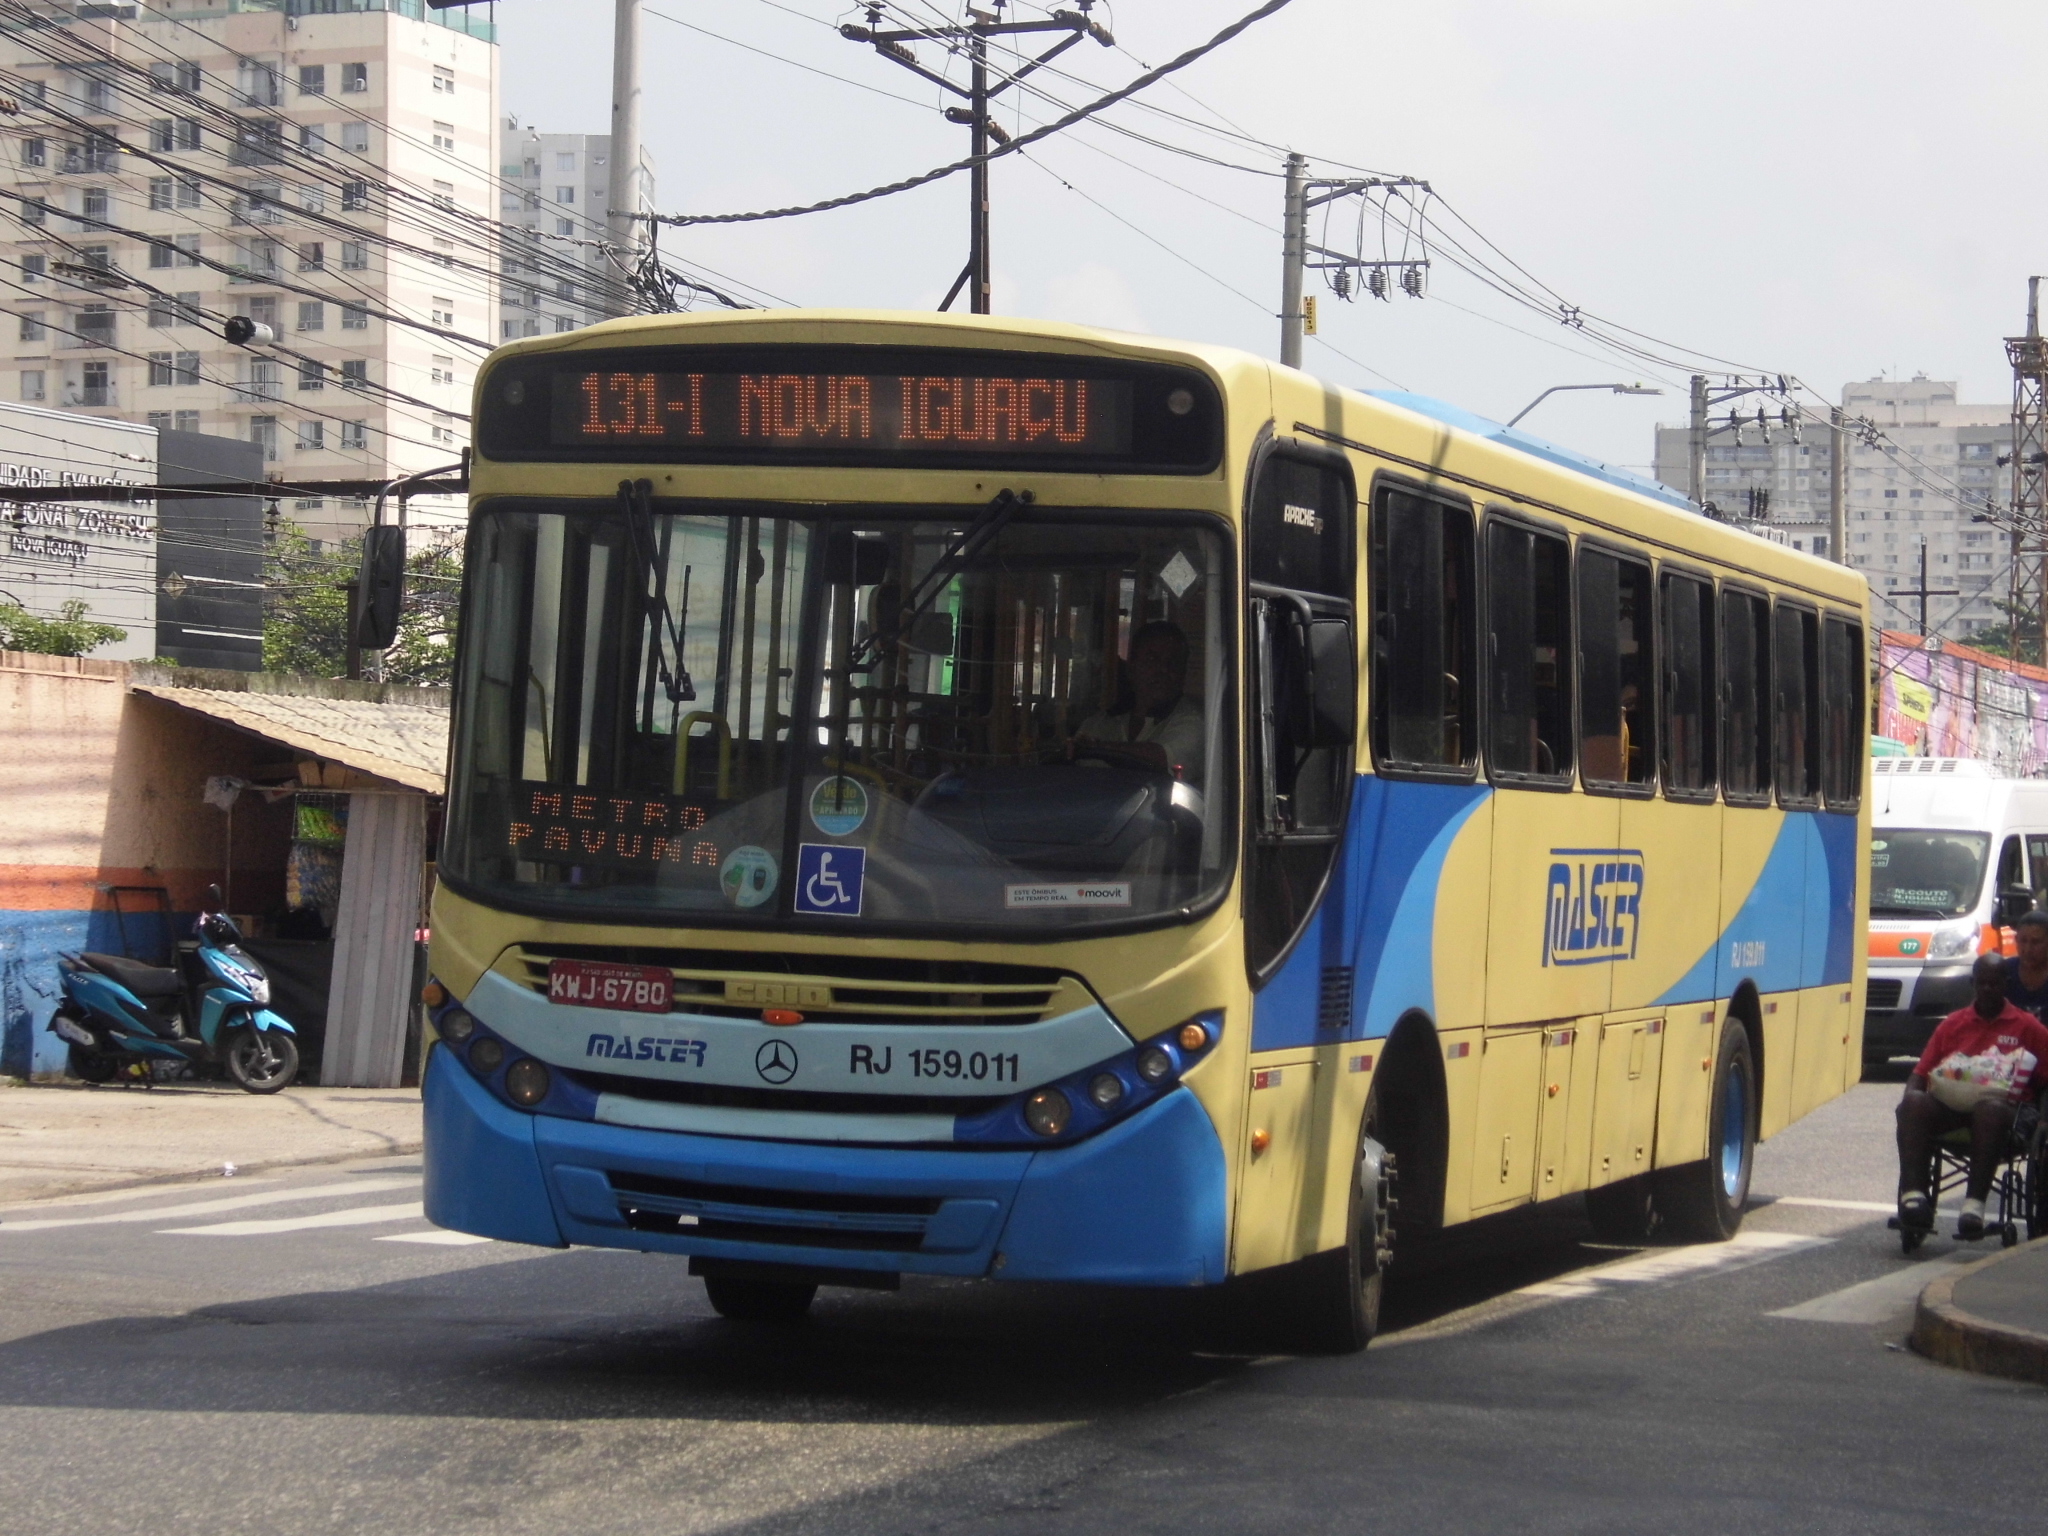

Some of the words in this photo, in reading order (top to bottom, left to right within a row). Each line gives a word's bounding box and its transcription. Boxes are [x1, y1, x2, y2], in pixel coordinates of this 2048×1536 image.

[739, 374, 870, 438] NOVA
[898, 377, 1086, 442] IGUAÇU
[129, 514, 154, 539] SUL
[1284, 504, 1315, 528] APACHE
[13, 536, 44, 553] NOVA
[46, 540, 90, 562] IGUAÇU
[531, 791, 707, 831] METRO
[508, 822, 718, 867] PAVUNA
[1085, 888, 1122, 898] moovit
[1541, 862, 1644, 968] MASTER
[1902, 942, 1918, 950] 177
[586, 1033, 707, 1068] MASTER
[850, 1044, 892, 1075] RJ
[908, 1049, 1019, 1082] 159.011
